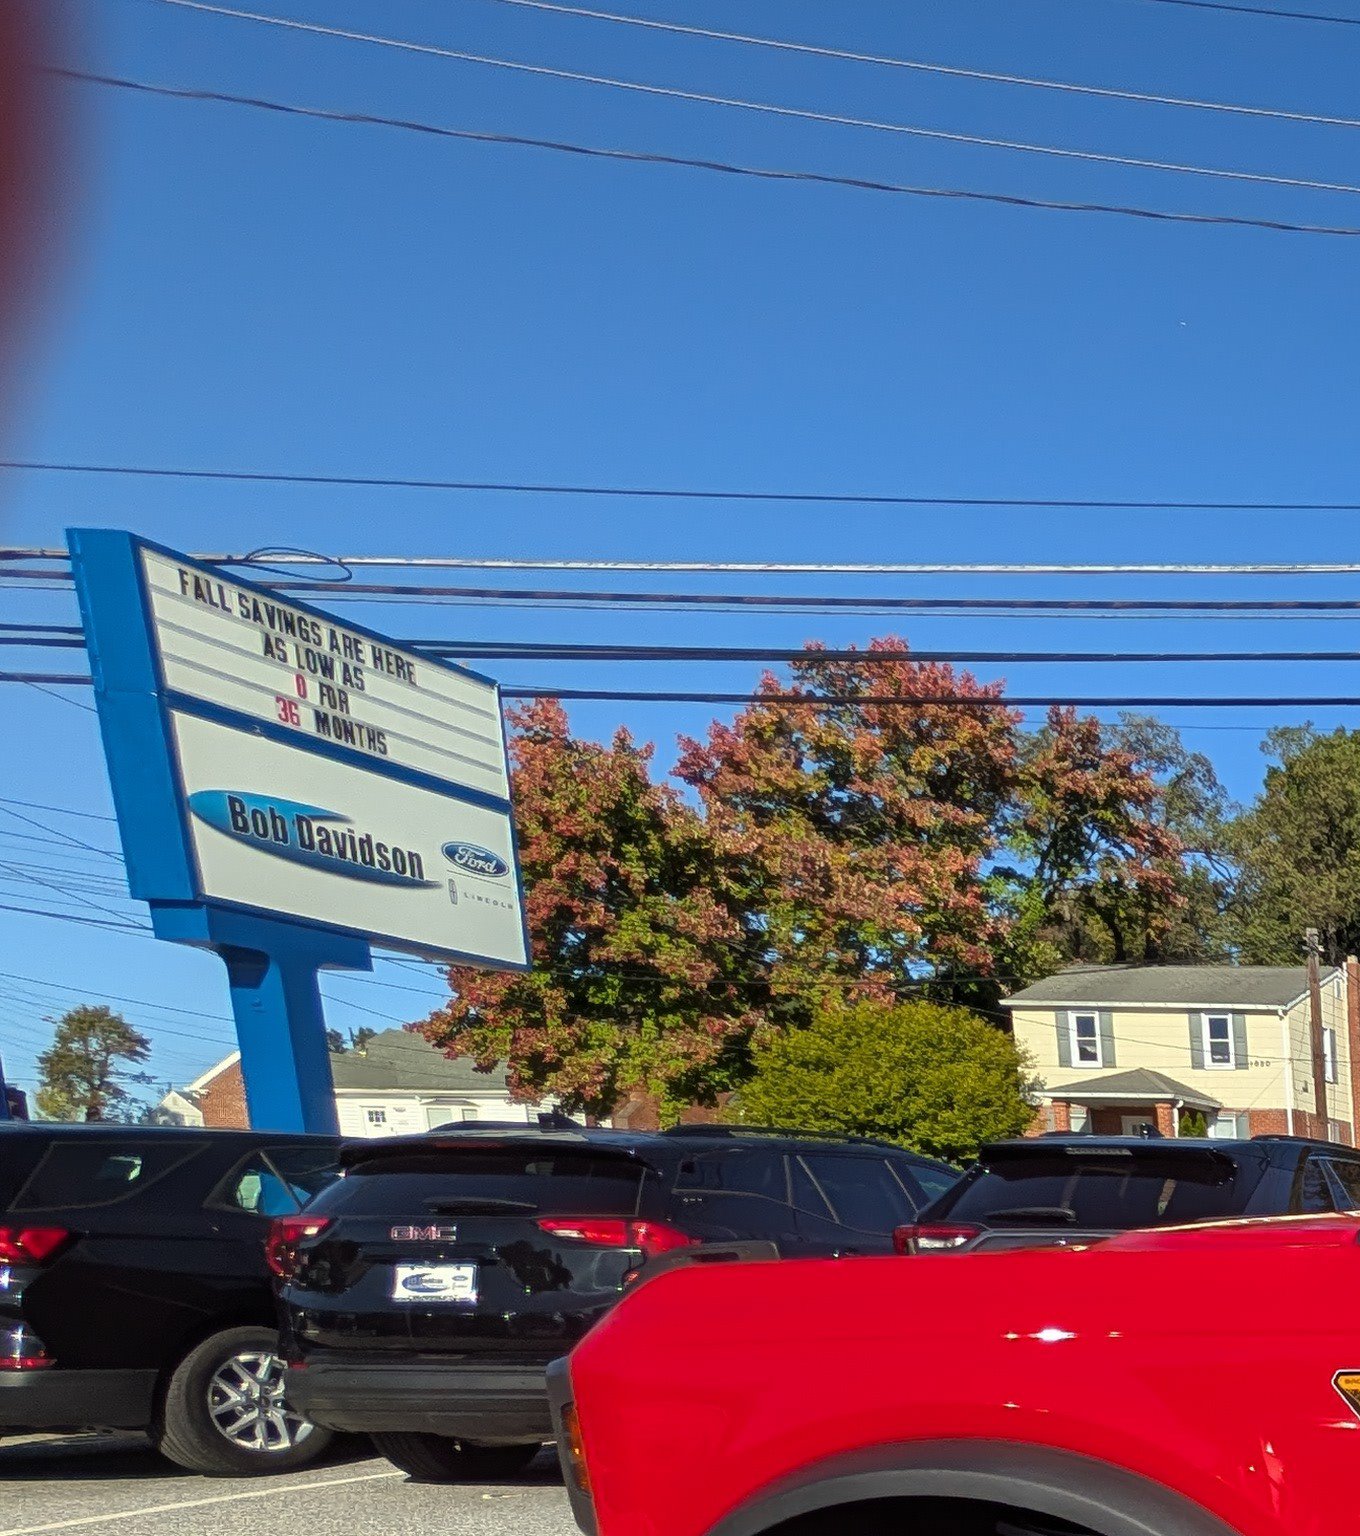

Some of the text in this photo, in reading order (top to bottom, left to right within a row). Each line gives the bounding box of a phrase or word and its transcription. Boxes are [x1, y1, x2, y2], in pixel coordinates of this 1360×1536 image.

[178, 568, 417, 688] FALL SAVINGS ARE HERE
[263, 633, 365, 692] AS LOW AS
[275, 695, 388, 756] 36 MONTHS
[320, 683, 350, 715] FOR
[227, 794, 425, 881] Bob Davidson
[454, 846, 497, 873] Ford
[390, 1226, 457, 1241] GMC
